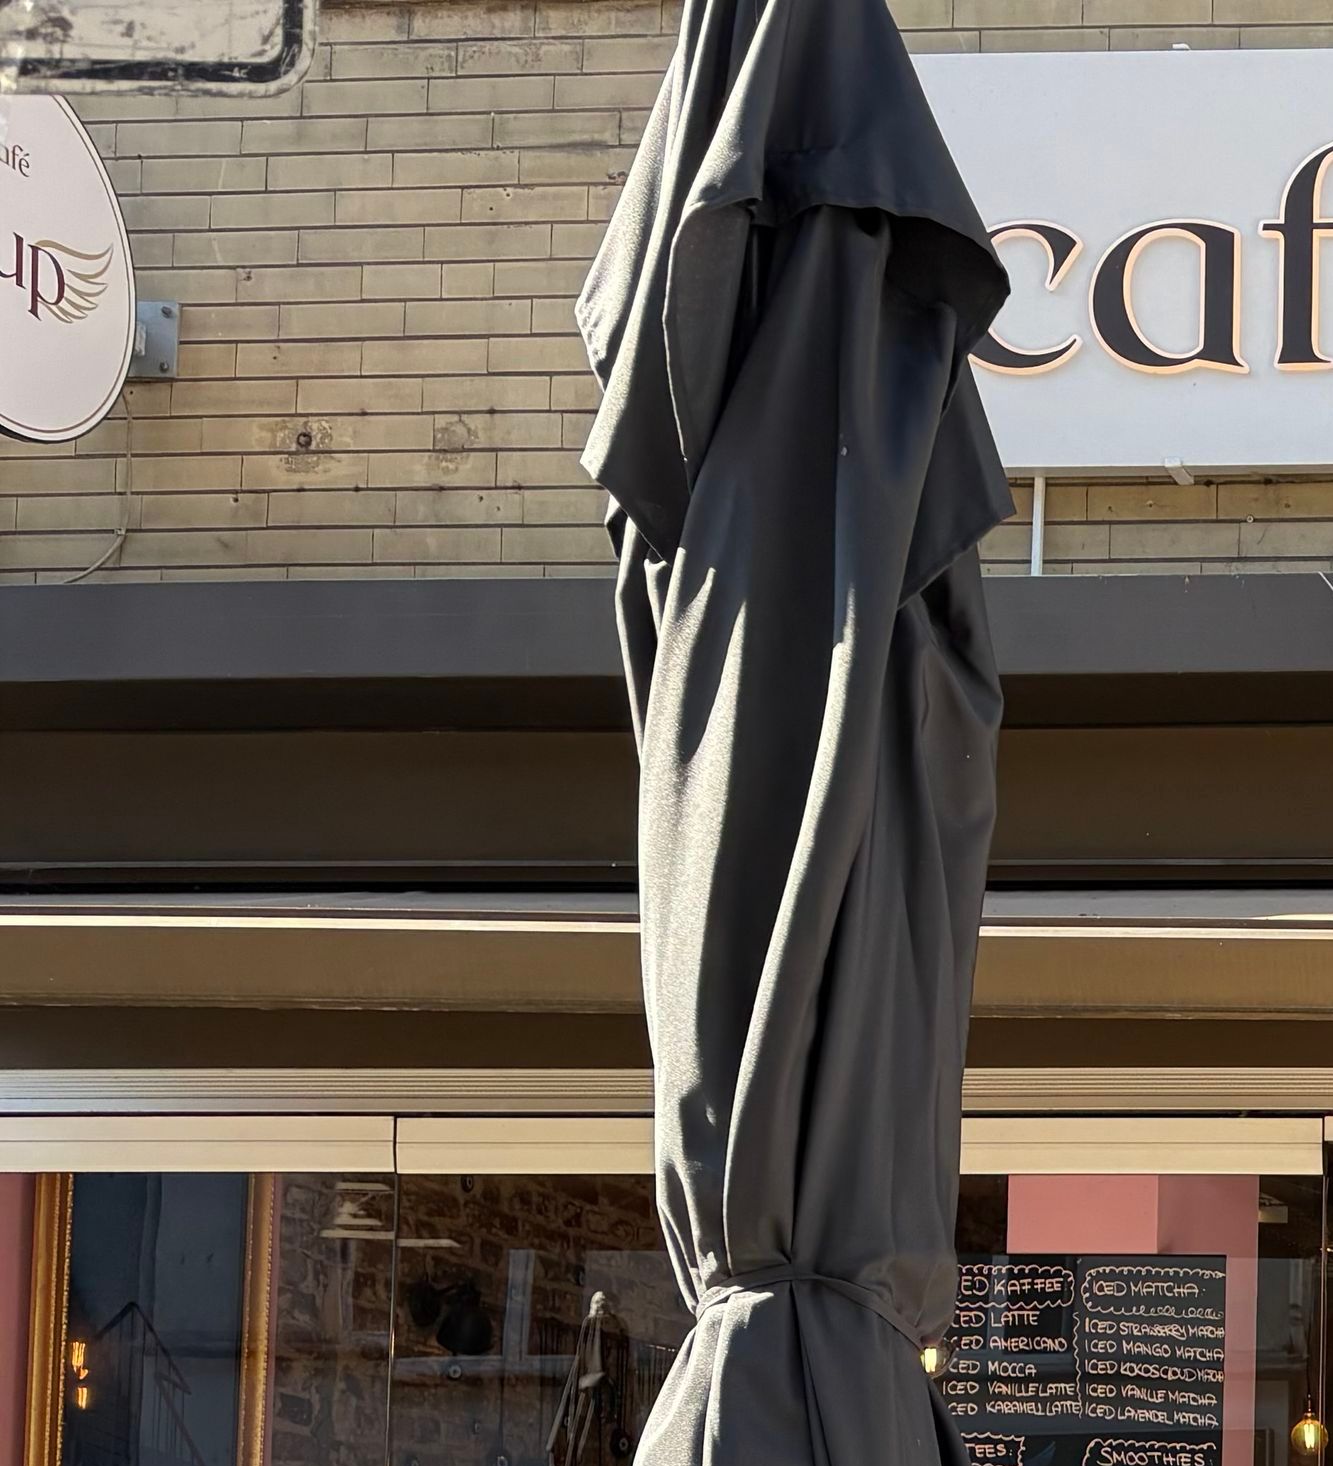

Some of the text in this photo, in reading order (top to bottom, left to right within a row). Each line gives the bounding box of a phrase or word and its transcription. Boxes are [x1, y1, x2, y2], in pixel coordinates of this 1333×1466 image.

[994, 1276, 1064, 1295] KAFFEE
[1092, 1281, 1128, 1298] ICED
[950, 1311, 1041, 1328] CED LATTE
[1085, 1317, 1117, 1334] ICED
[949, 1335, 1068, 1352] CED AMERICANO
[1085, 1338, 1225, 1362] ICED MANGO MATCHA
[948, 1357, 1038, 1378] CED MOCCA
[1085, 1359, 1117, 1375] ICED
[942, 1381, 980, 1396] ICED
[1085, 1382, 1117, 1398] ICED
[1166, 1390, 1219, 1407] MATCHA
[947, 1402, 979, 1416] CED
[1085, 1403, 1116, 1420] ICED
[1173, 1410, 1220, 1429] MATCHA
